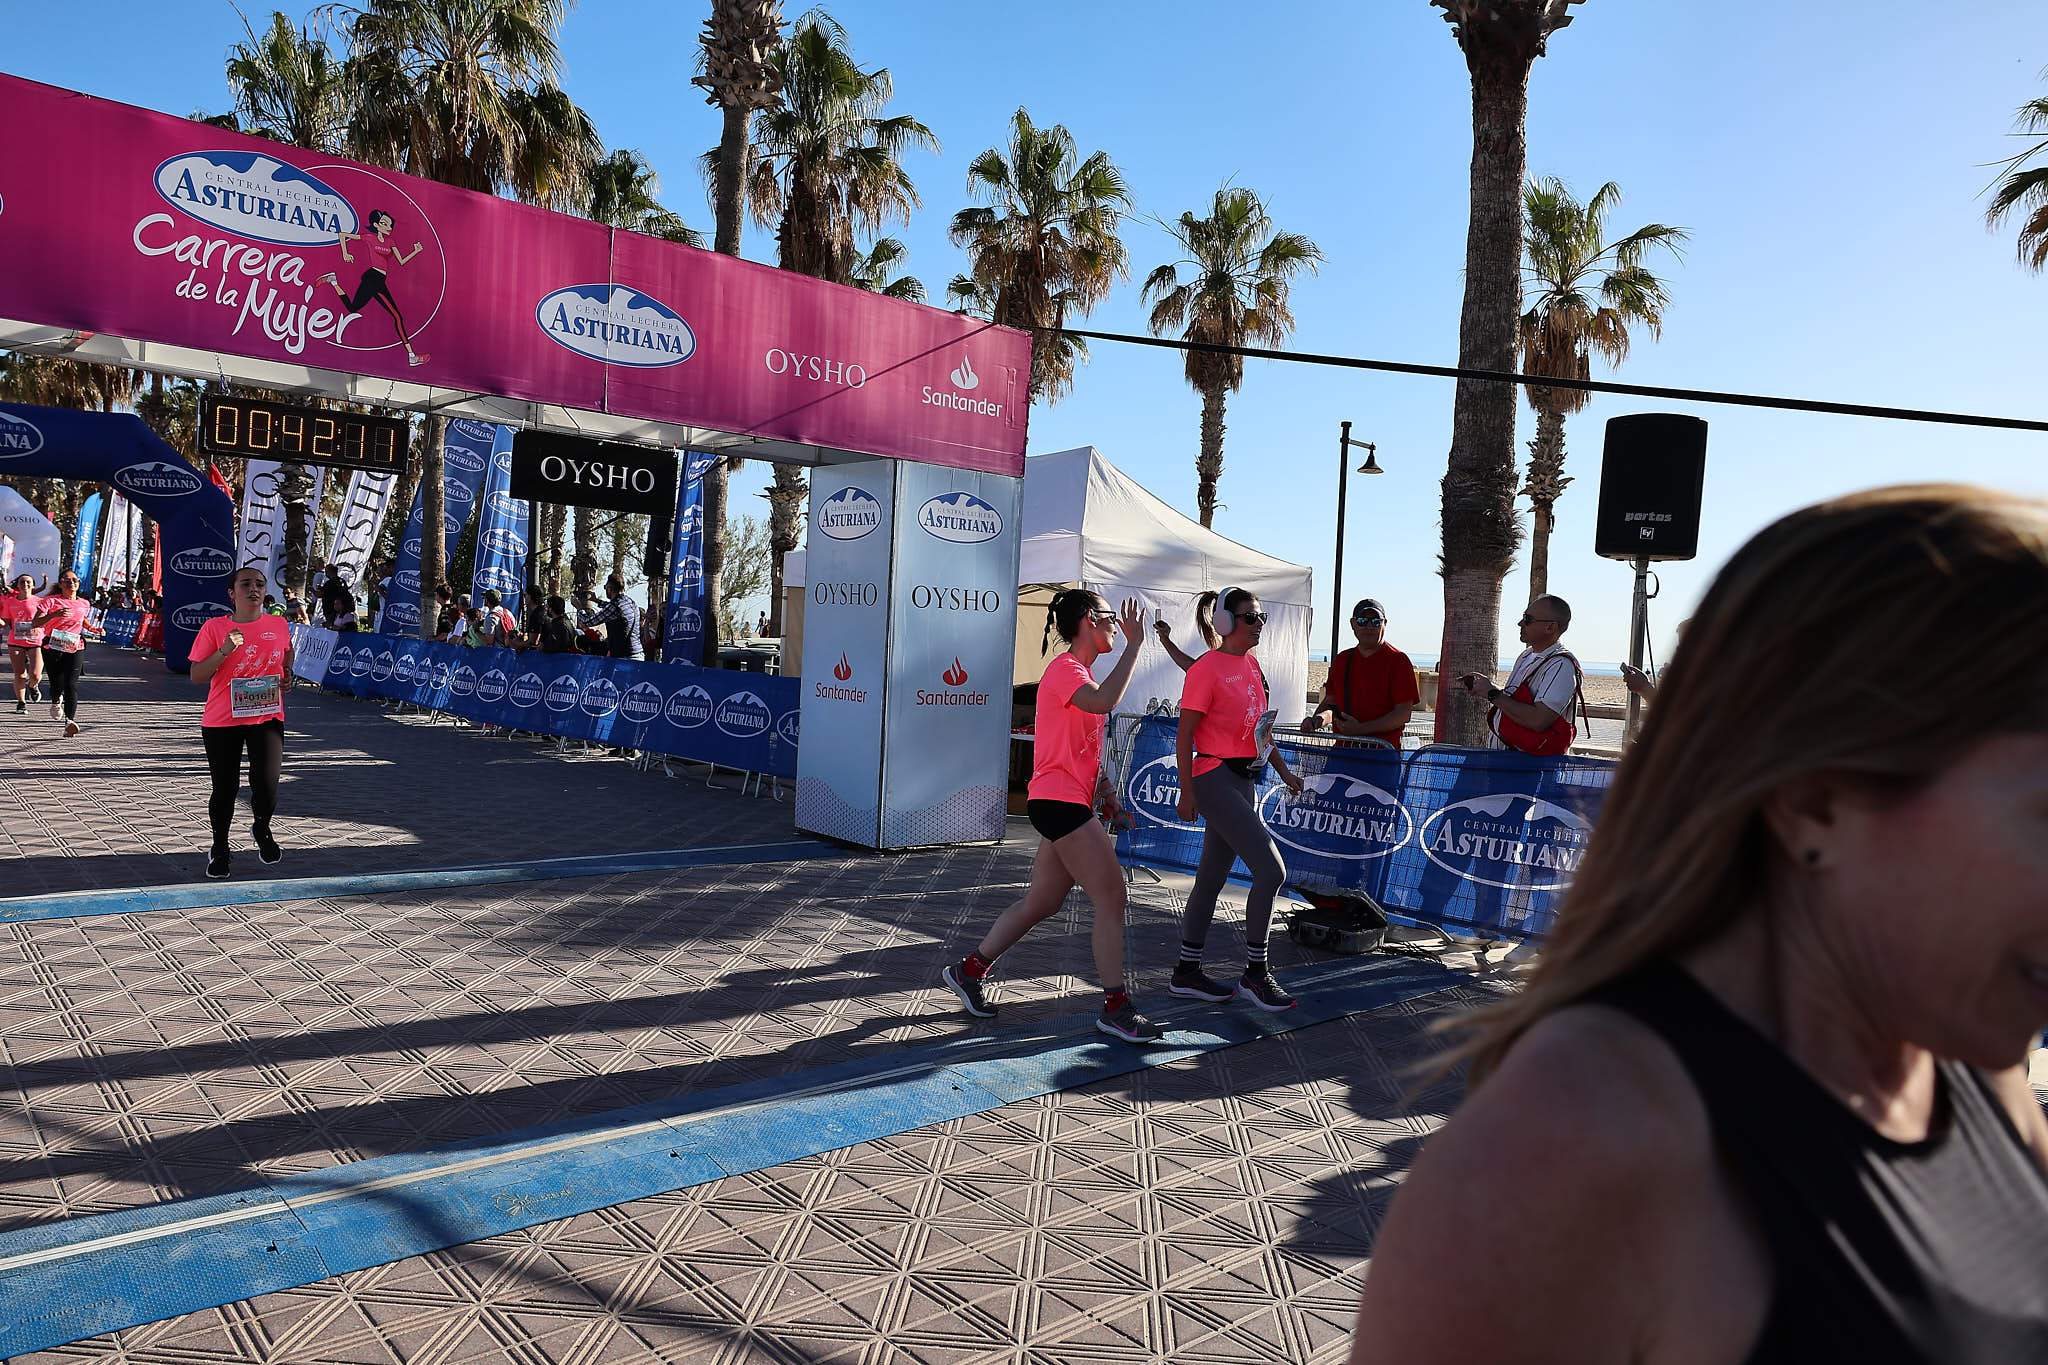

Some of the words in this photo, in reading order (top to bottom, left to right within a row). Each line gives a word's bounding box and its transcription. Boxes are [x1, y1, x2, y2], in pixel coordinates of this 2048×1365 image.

[170, 167, 342, 235] ASTURIANA
[205, 171, 270, 194] CENTRAL
[276, 187, 340, 210] LECHERA
[133, 212, 305, 286] Carrera
[175, 268, 209, 301] de
[215, 273, 239, 308] la
[231, 277, 363, 355] Mujer
[575, 304, 627, 321] CENTRAL
[631, 315, 681, 332] LECHERA
[549, 302, 684, 355] ASTURIANA
[764, 348, 867, 389] OYSHO
[921, 385, 1003, 417] Santander
[215, 405, 394, 462] 00:42:11
[122, 473, 197, 490] ASTURIANA
[540, 455, 655, 493] OYSHO
[3, 515, 40, 525] OYSHO
[821, 507, 877, 528] ASTURIANA
[923, 507, 996, 534] ASTURIANA
[175, 555, 232, 571] ASTURIANA
[815, 582, 878, 607] OYSHO
[911, 585, 1000, 613] OYSHO
[622, 695, 658, 714] ASTURIANA
[815, 682, 868, 703] Santander
[916, 689, 989, 706] Santander
[667, 699, 708, 720] ASTURIANA
[718, 705, 765, 729] ASTURIANA
[1268, 796, 1398, 844] ASTURIANA
[1345, 802, 1398, 818] LECHERA
[1463, 819, 1520, 835] CENTRAL
